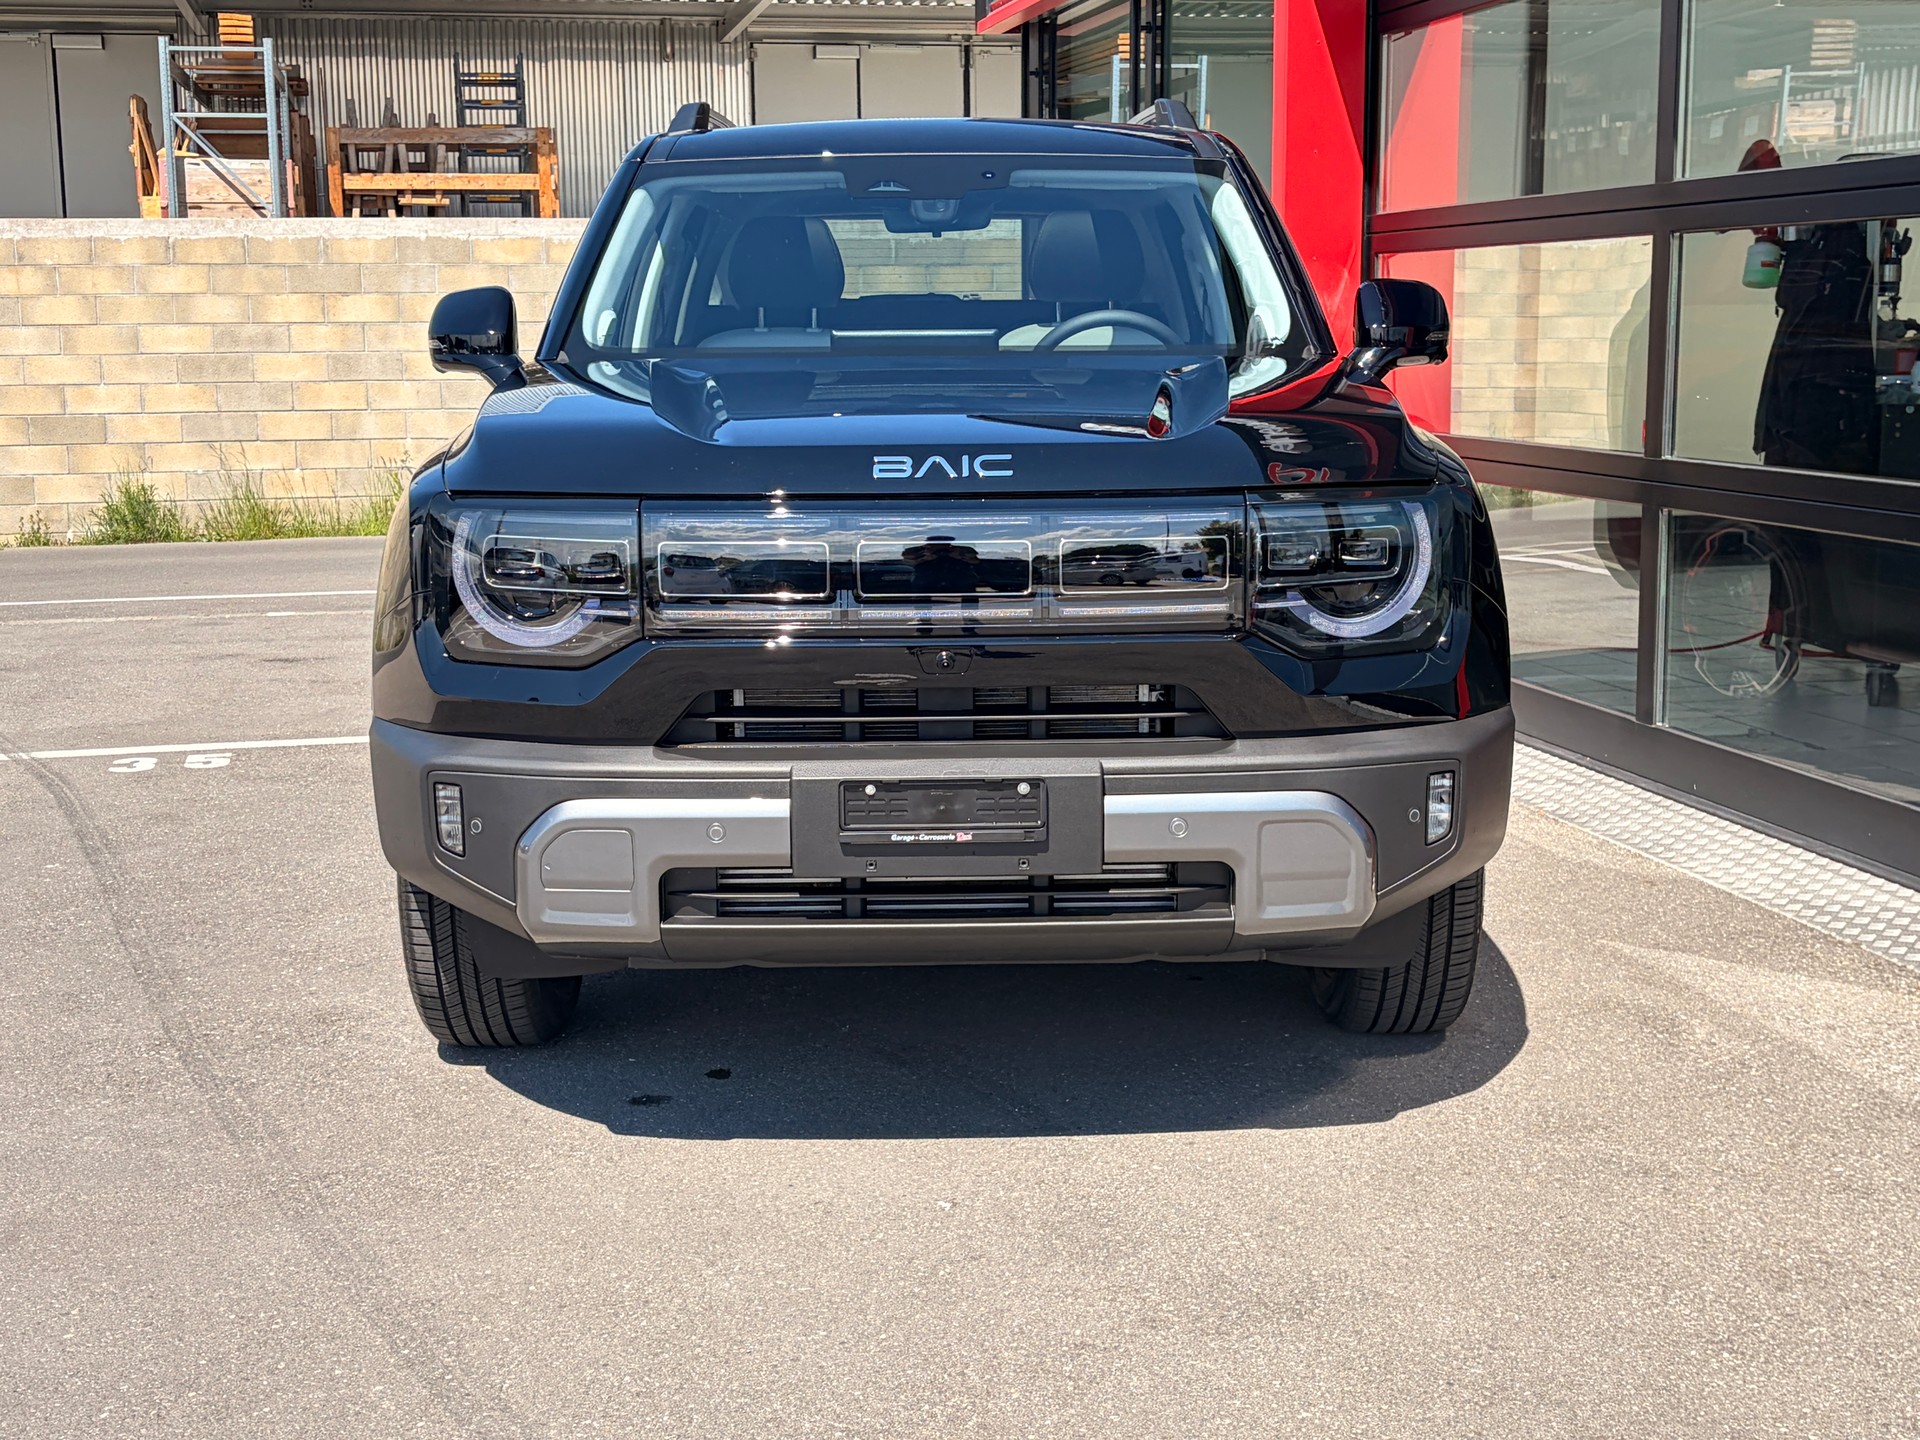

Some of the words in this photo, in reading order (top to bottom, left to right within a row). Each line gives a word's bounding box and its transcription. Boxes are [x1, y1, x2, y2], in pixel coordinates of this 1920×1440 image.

[872, 454, 1014, 479] BAIC
[890, 833, 915, 842] Garage
[919, 833, 956, 841] Carrosserie
